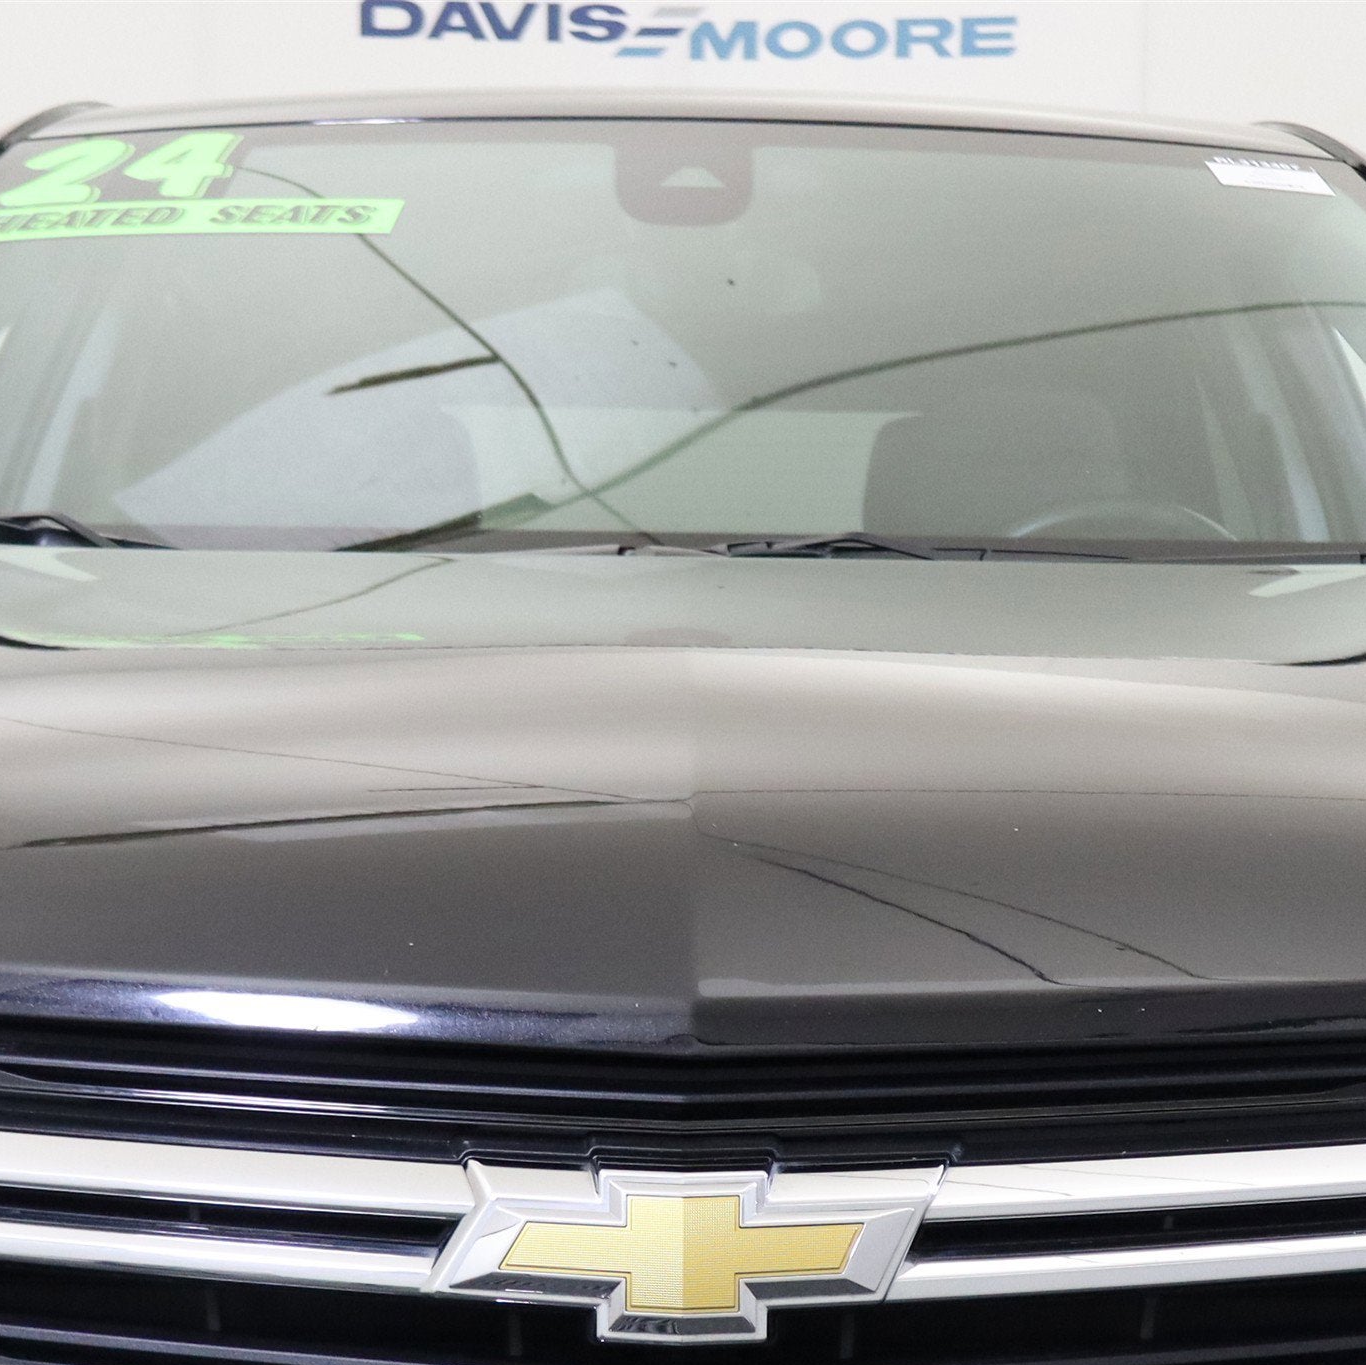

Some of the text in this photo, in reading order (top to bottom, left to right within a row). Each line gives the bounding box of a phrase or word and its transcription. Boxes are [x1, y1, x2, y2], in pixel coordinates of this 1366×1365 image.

[361, 1, 1017, 60] DAVIS MOORE
[209, 205, 373, 226] SEATS
